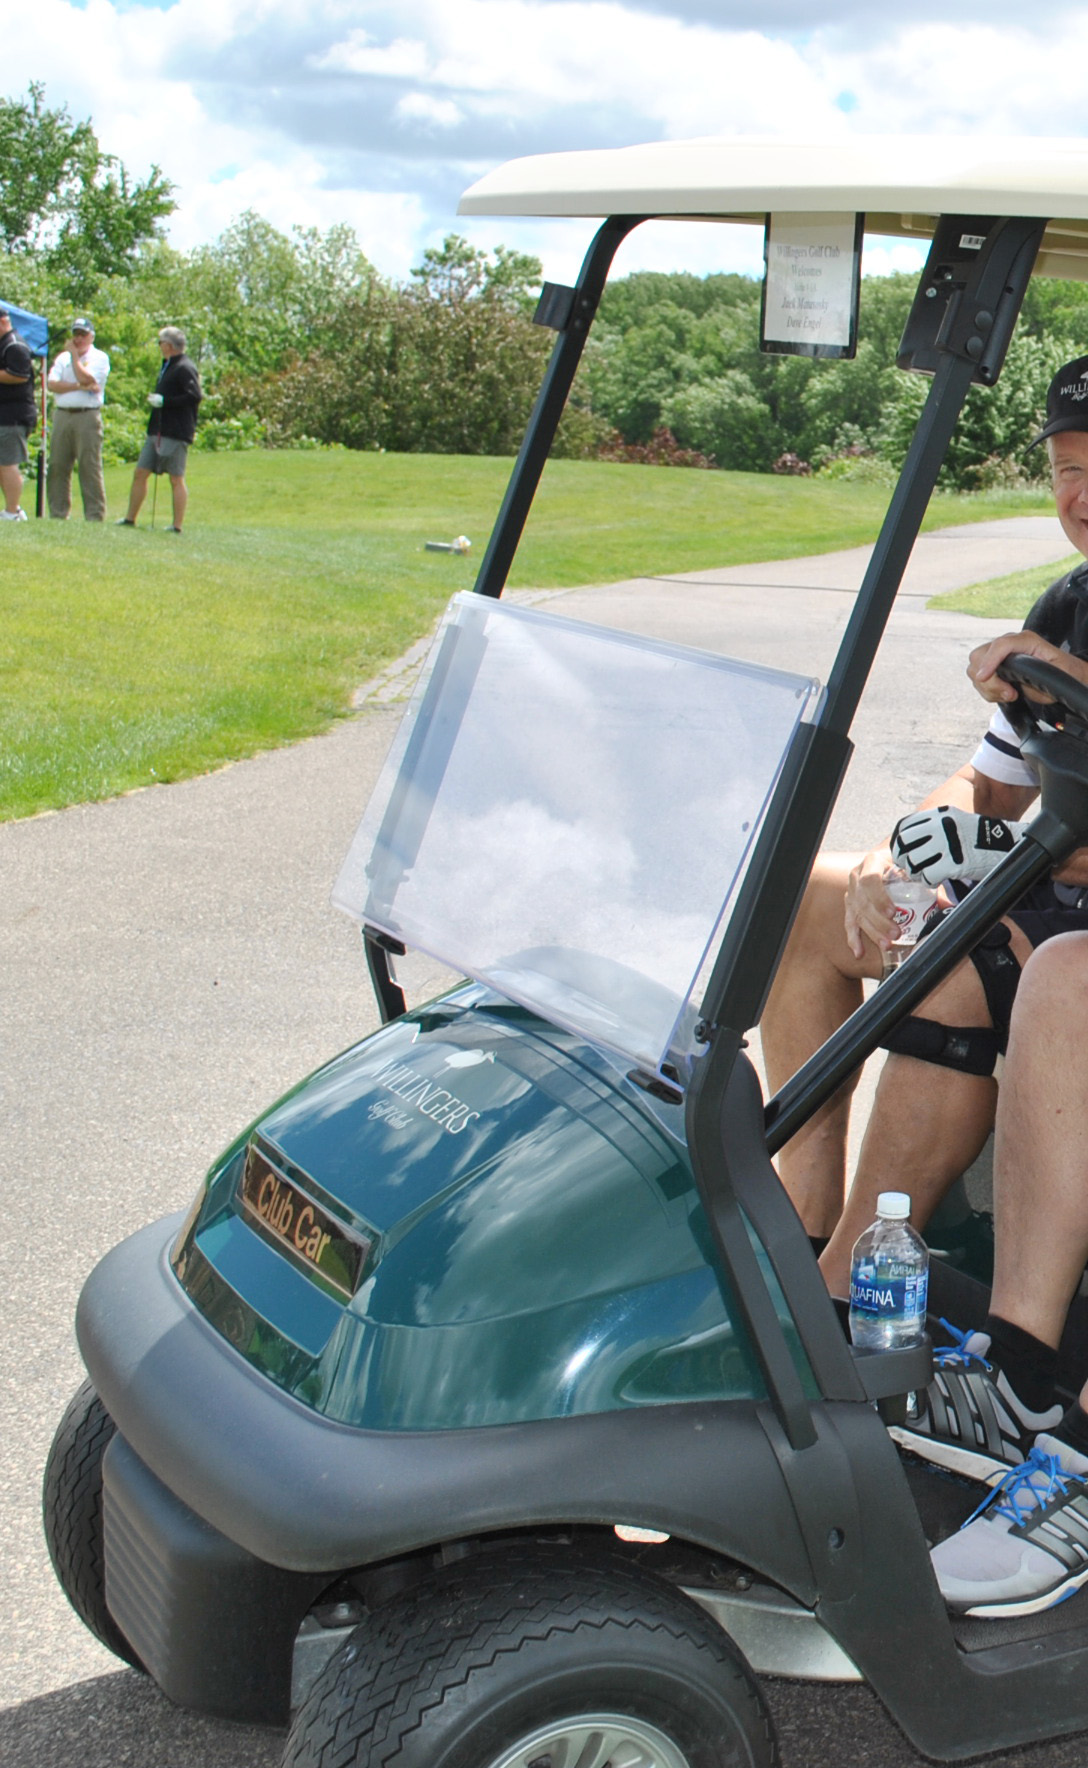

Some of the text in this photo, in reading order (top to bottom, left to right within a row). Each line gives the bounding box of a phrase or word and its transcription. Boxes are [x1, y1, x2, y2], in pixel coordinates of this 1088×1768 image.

[808, 245, 823, 257] Golf
[824, 245, 840, 257] Club
[370, 1058, 481, 1134] WILLINGERS
[257, 1173, 332, 1264] Club Car
